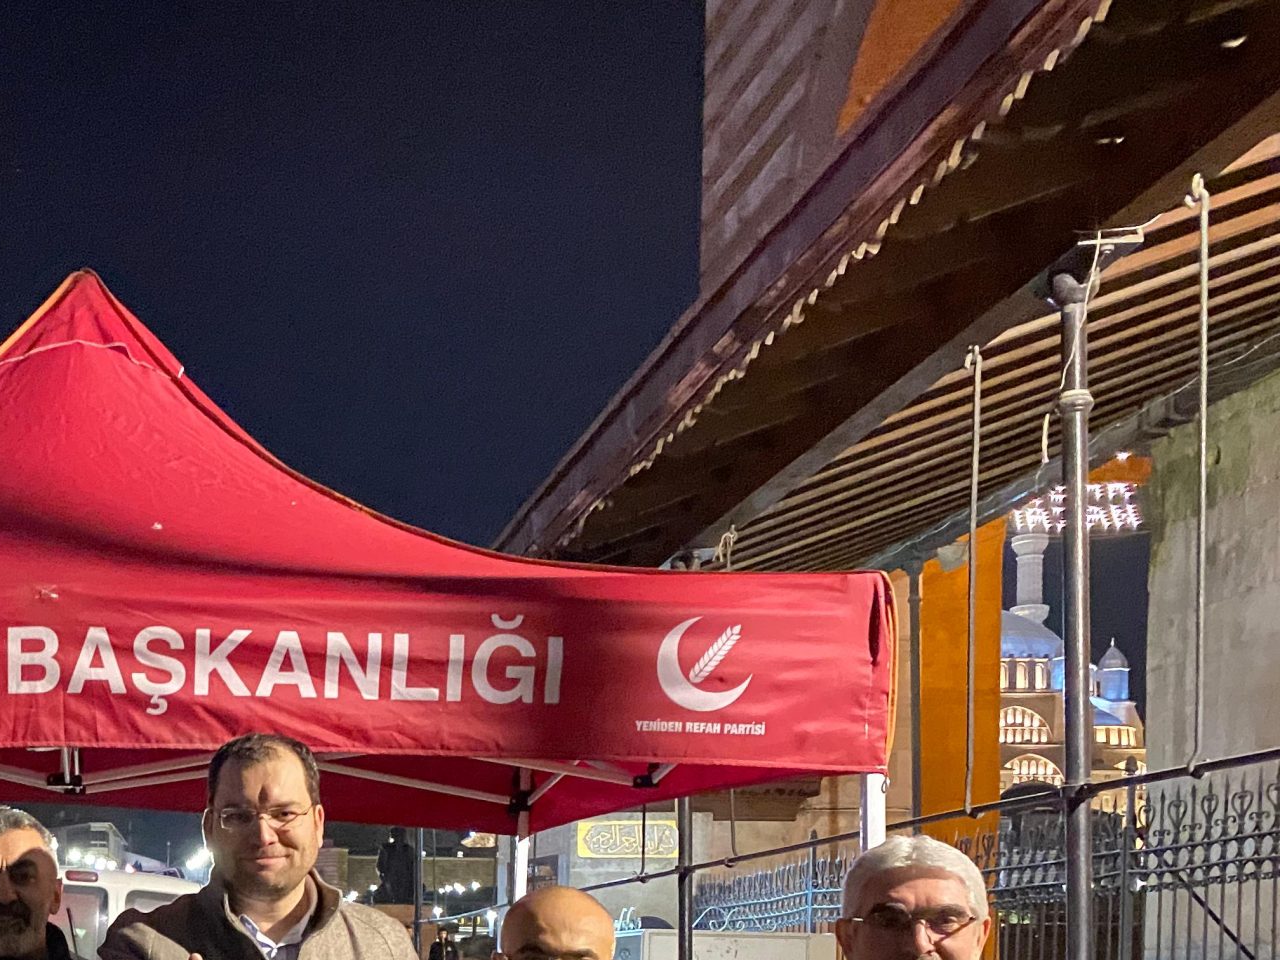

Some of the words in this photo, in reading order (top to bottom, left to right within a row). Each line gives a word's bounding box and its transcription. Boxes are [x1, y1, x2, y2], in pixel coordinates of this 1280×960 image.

[7, 613, 564, 715] BAŞKANLIĞI
[635, 718, 683, 733] YENİDEN
[685, 721, 721, 735] REFAH
[723, 721, 766, 736] PARTİSİ
